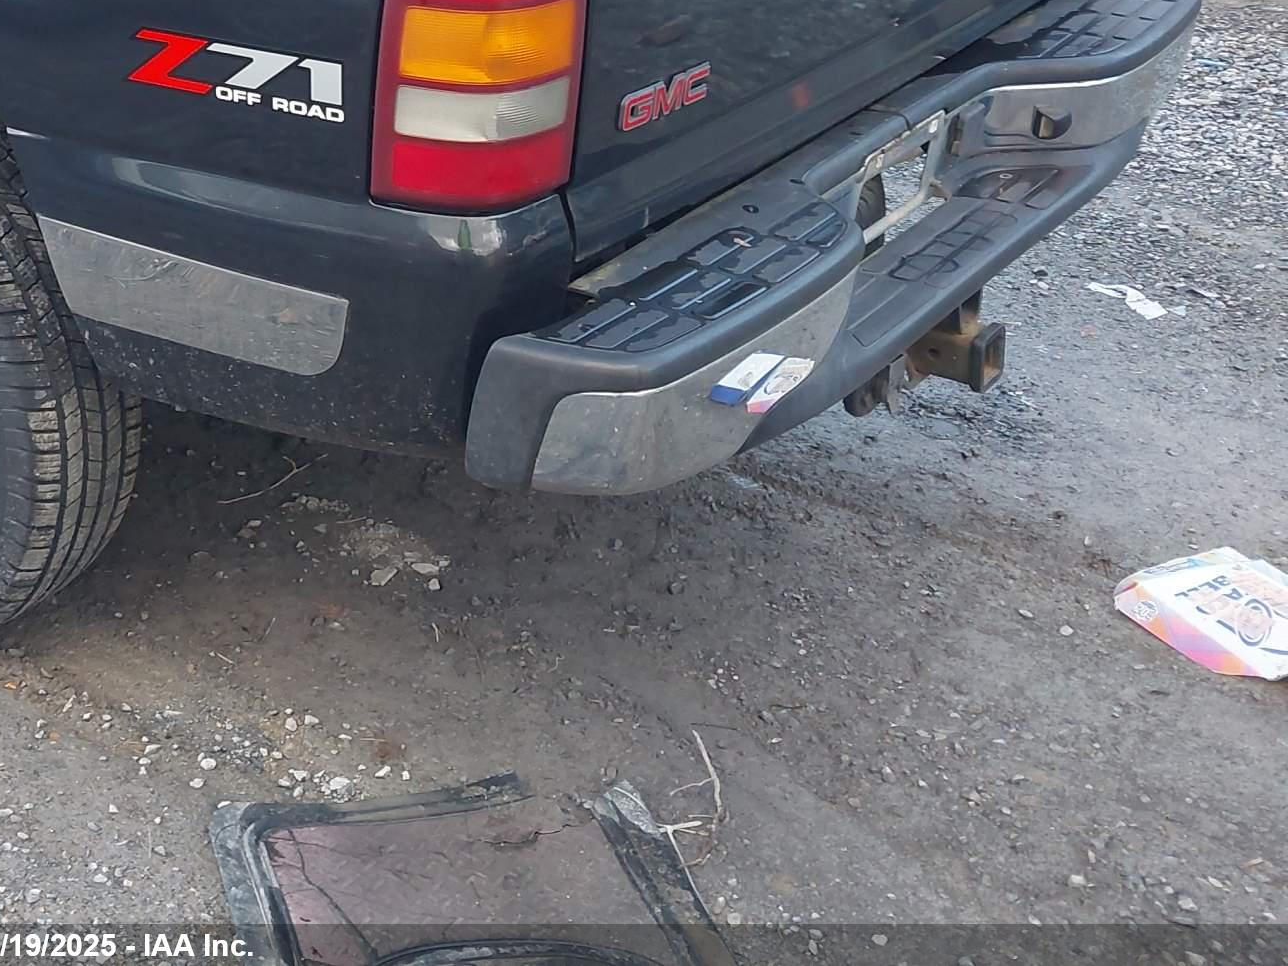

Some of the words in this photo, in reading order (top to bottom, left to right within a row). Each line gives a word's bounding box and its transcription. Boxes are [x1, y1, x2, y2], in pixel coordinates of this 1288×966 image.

[128, 29, 343, 106] Z71
[620, 61, 711, 132] GMC
[215, 86, 262, 106] OFF
[271, 96, 345, 123] ROAD
